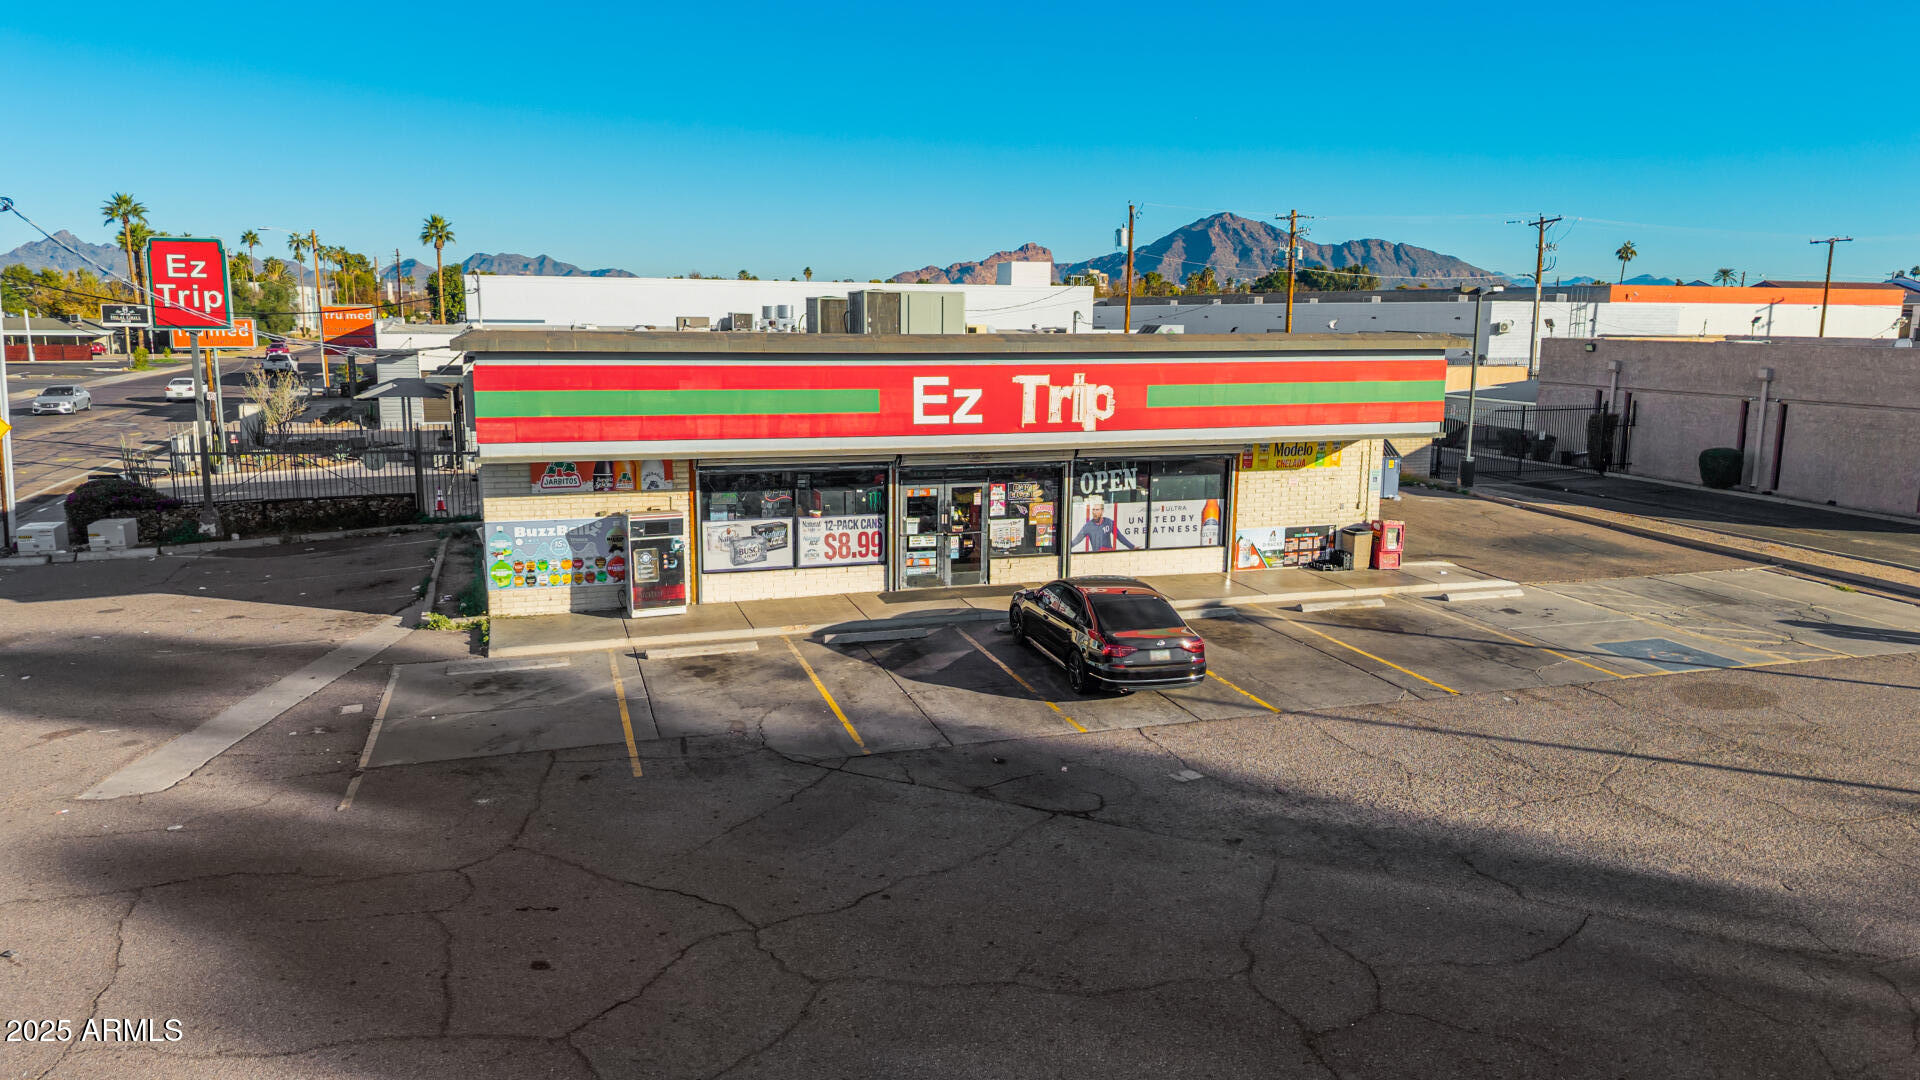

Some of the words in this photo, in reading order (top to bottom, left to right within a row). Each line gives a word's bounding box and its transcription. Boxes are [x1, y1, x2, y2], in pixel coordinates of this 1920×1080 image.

[166, 253, 208, 278] Ez
[155, 283, 223, 314] Trip
[913, 376, 983, 425] Ez
[1011, 372, 1116, 432] Trip
[1273, 441, 1313, 457] Modelo
[1080, 467, 1138, 494] OPEN
[824, 519, 859, 531] 12-PACK
[860, 518, 883, 530] CANS
[1128, 515, 1176, 525] UNTED
[1181, 514, 1194, 522] BY
[1102, 525, 1110, 534] 10
[1124, 525, 1198, 535] GREATNESS
[738, 545, 764, 556] BUSCH
[824, 530, 884, 561] $8.99
